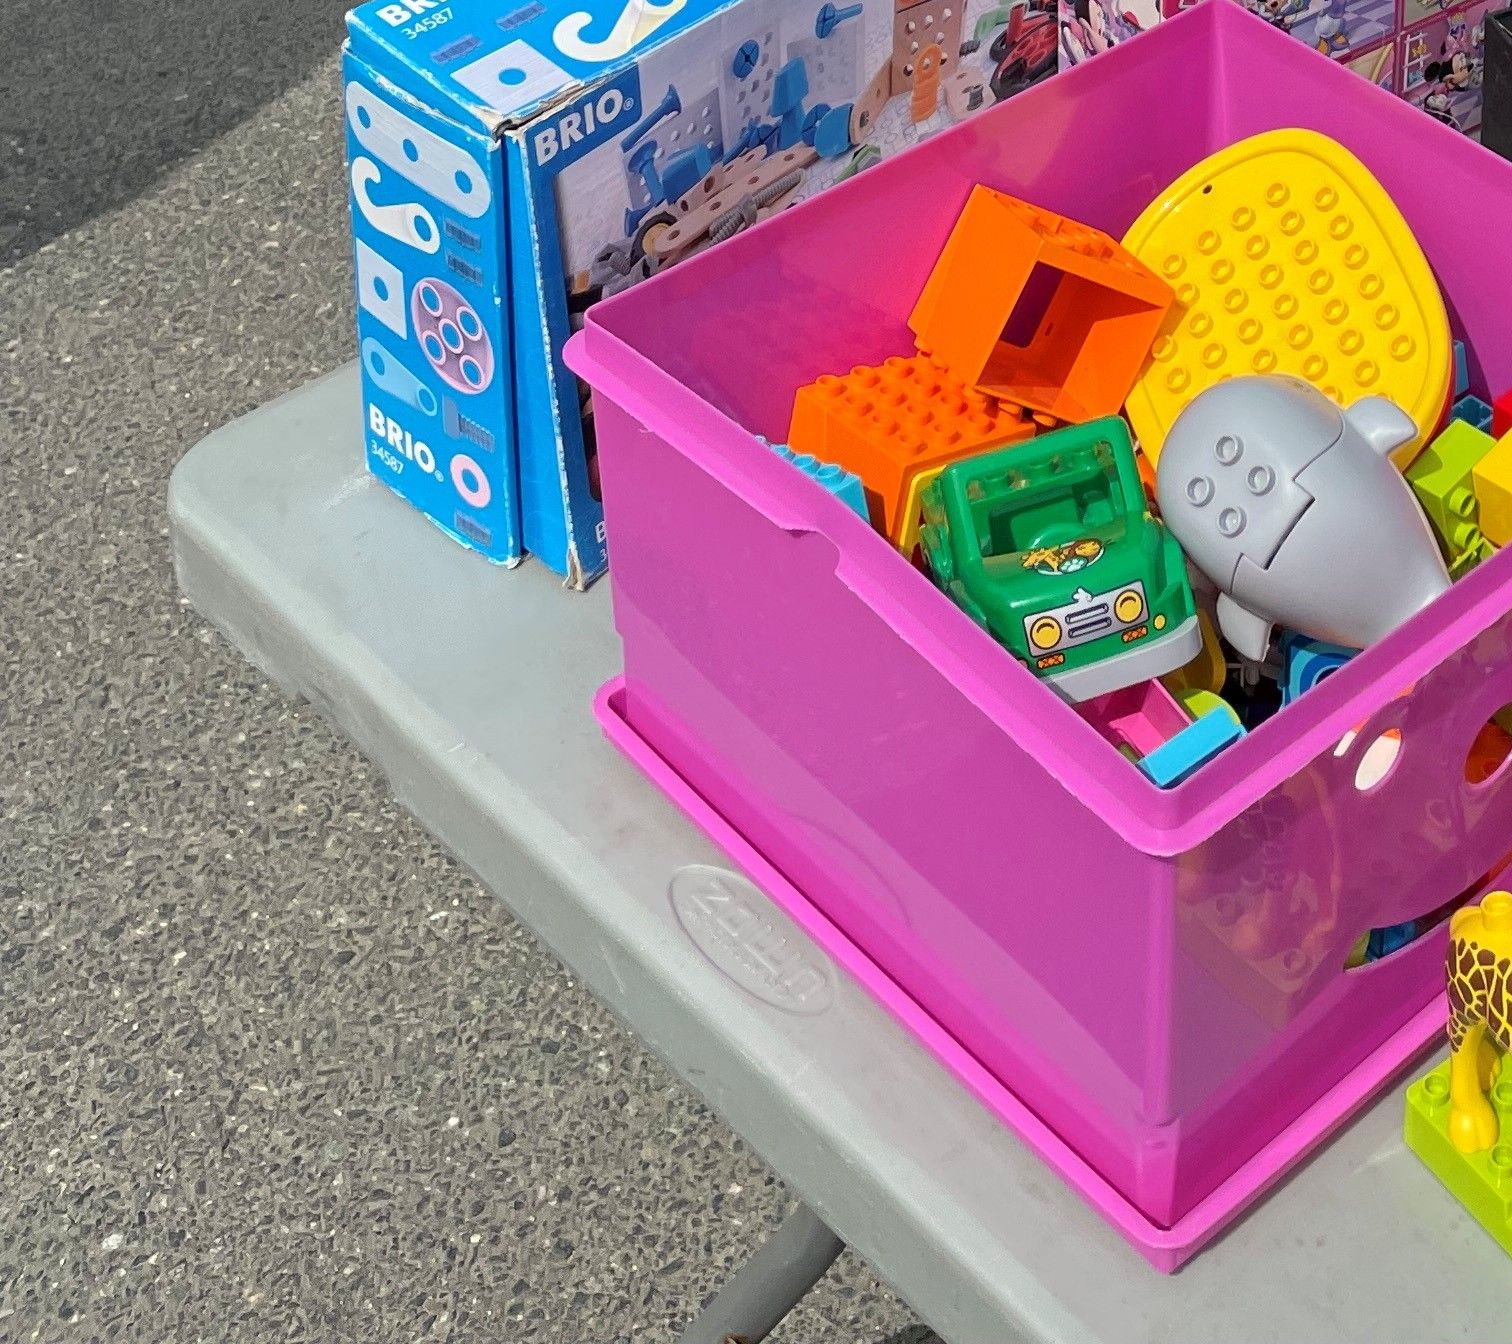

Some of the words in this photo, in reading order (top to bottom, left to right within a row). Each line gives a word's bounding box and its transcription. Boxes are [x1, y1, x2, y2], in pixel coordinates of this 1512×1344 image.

[401, 7, 453, 40] 34587
[534, 89, 623, 166] BRIO
[369, 402, 435, 474] BRIO
[371, 440, 404, 475] 34587
